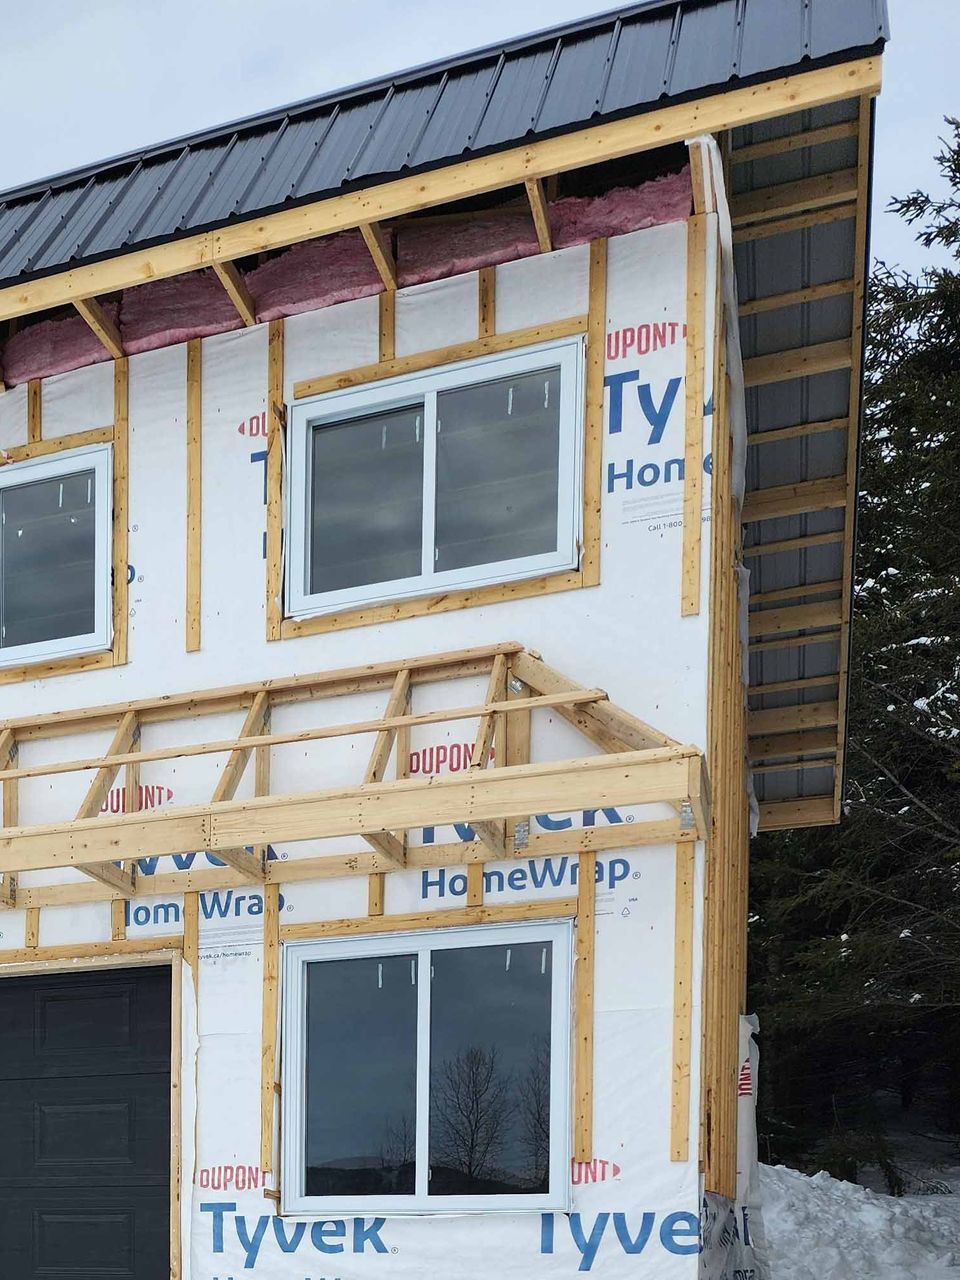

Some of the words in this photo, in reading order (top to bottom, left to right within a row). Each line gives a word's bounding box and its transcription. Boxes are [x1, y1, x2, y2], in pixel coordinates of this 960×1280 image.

[607, 322, 679, 361] UPONT
[409, 743, 476, 774] DUPON
[200, 1203, 389, 1268] Tyvek
